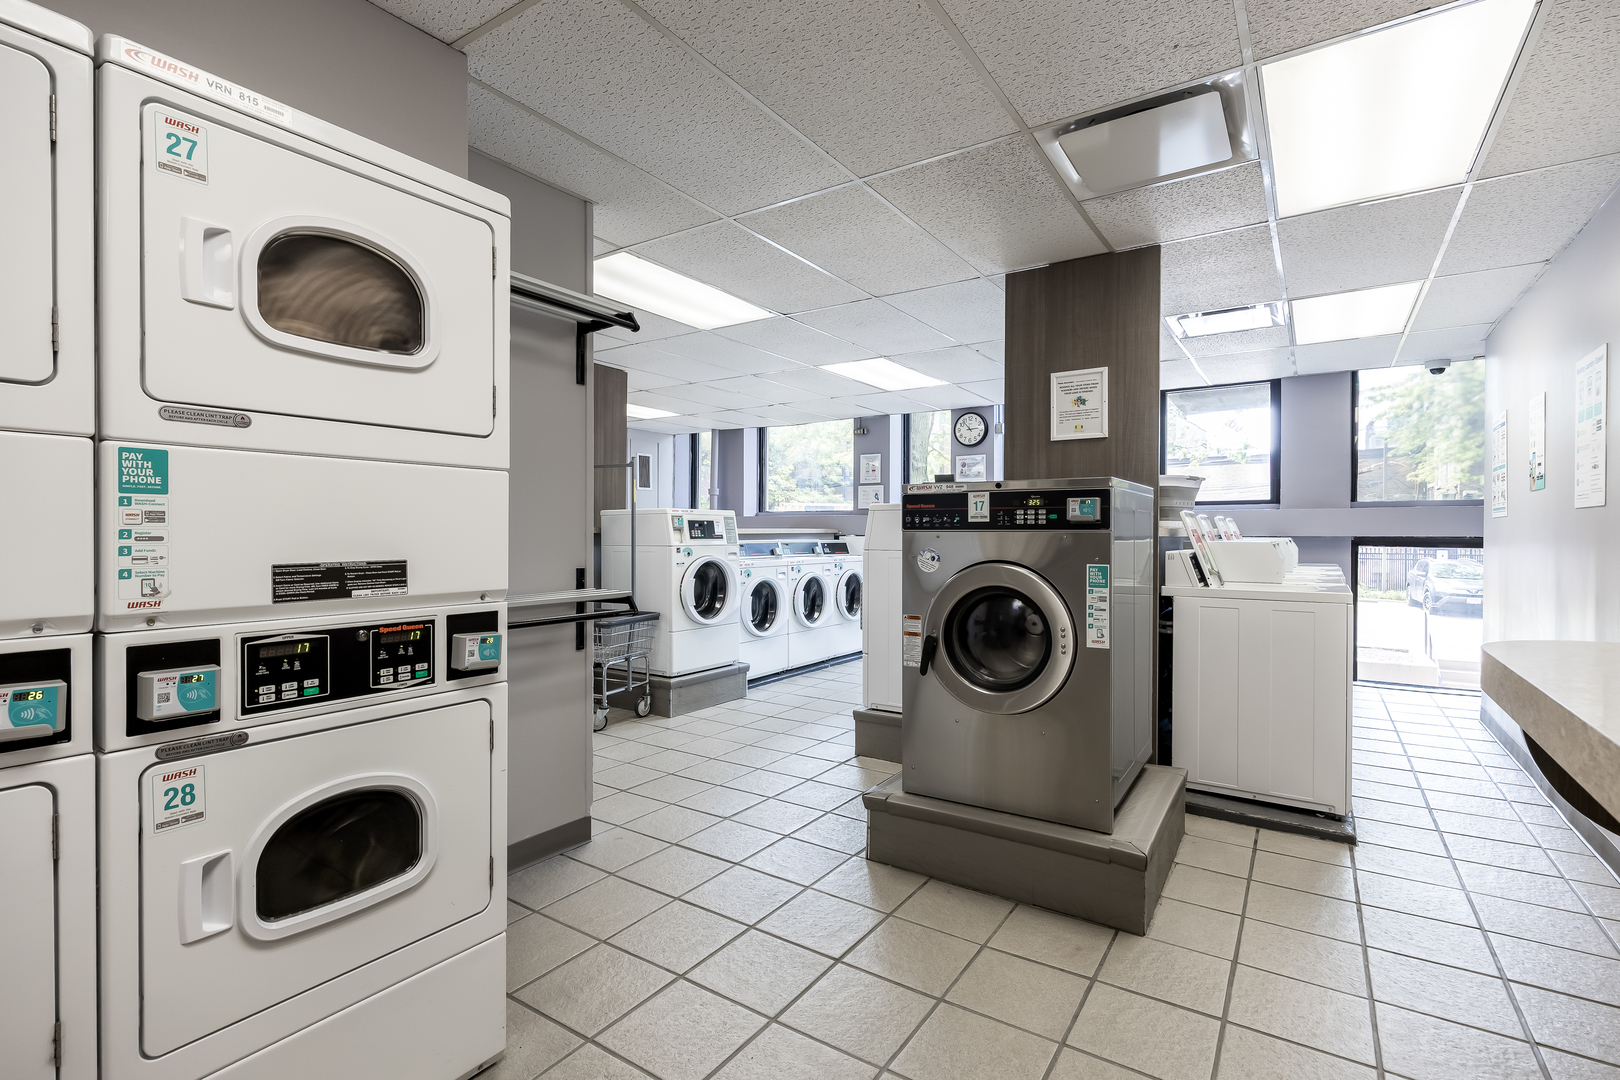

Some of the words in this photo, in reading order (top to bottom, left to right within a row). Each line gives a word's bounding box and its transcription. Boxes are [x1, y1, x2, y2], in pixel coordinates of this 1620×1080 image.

[150, 55, 200, 82] WASH
[206, 78, 232, 96] VRN
[238, 92, 259, 106] 815
[165, 117, 199, 134] WASH
[166, 132, 198, 160] 27
[122, 452, 143, 460] PAY
[122, 460, 151, 468] WITH
[122, 468, 153, 476] YOUR
[122, 476, 162, 484] PHONE
[973, 501, 985, 511] 17
[127, 600, 161, 609] WASH
[379, 625, 401, 633] Speed
[411, 631, 420, 640] 17
[298, 643, 309, 653] 17
[192, 674, 204, 682] 27
[28, 691, 43, 700] 26
[162, 768, 197, 782] WASH
[164, 783, 195, 811] 28
